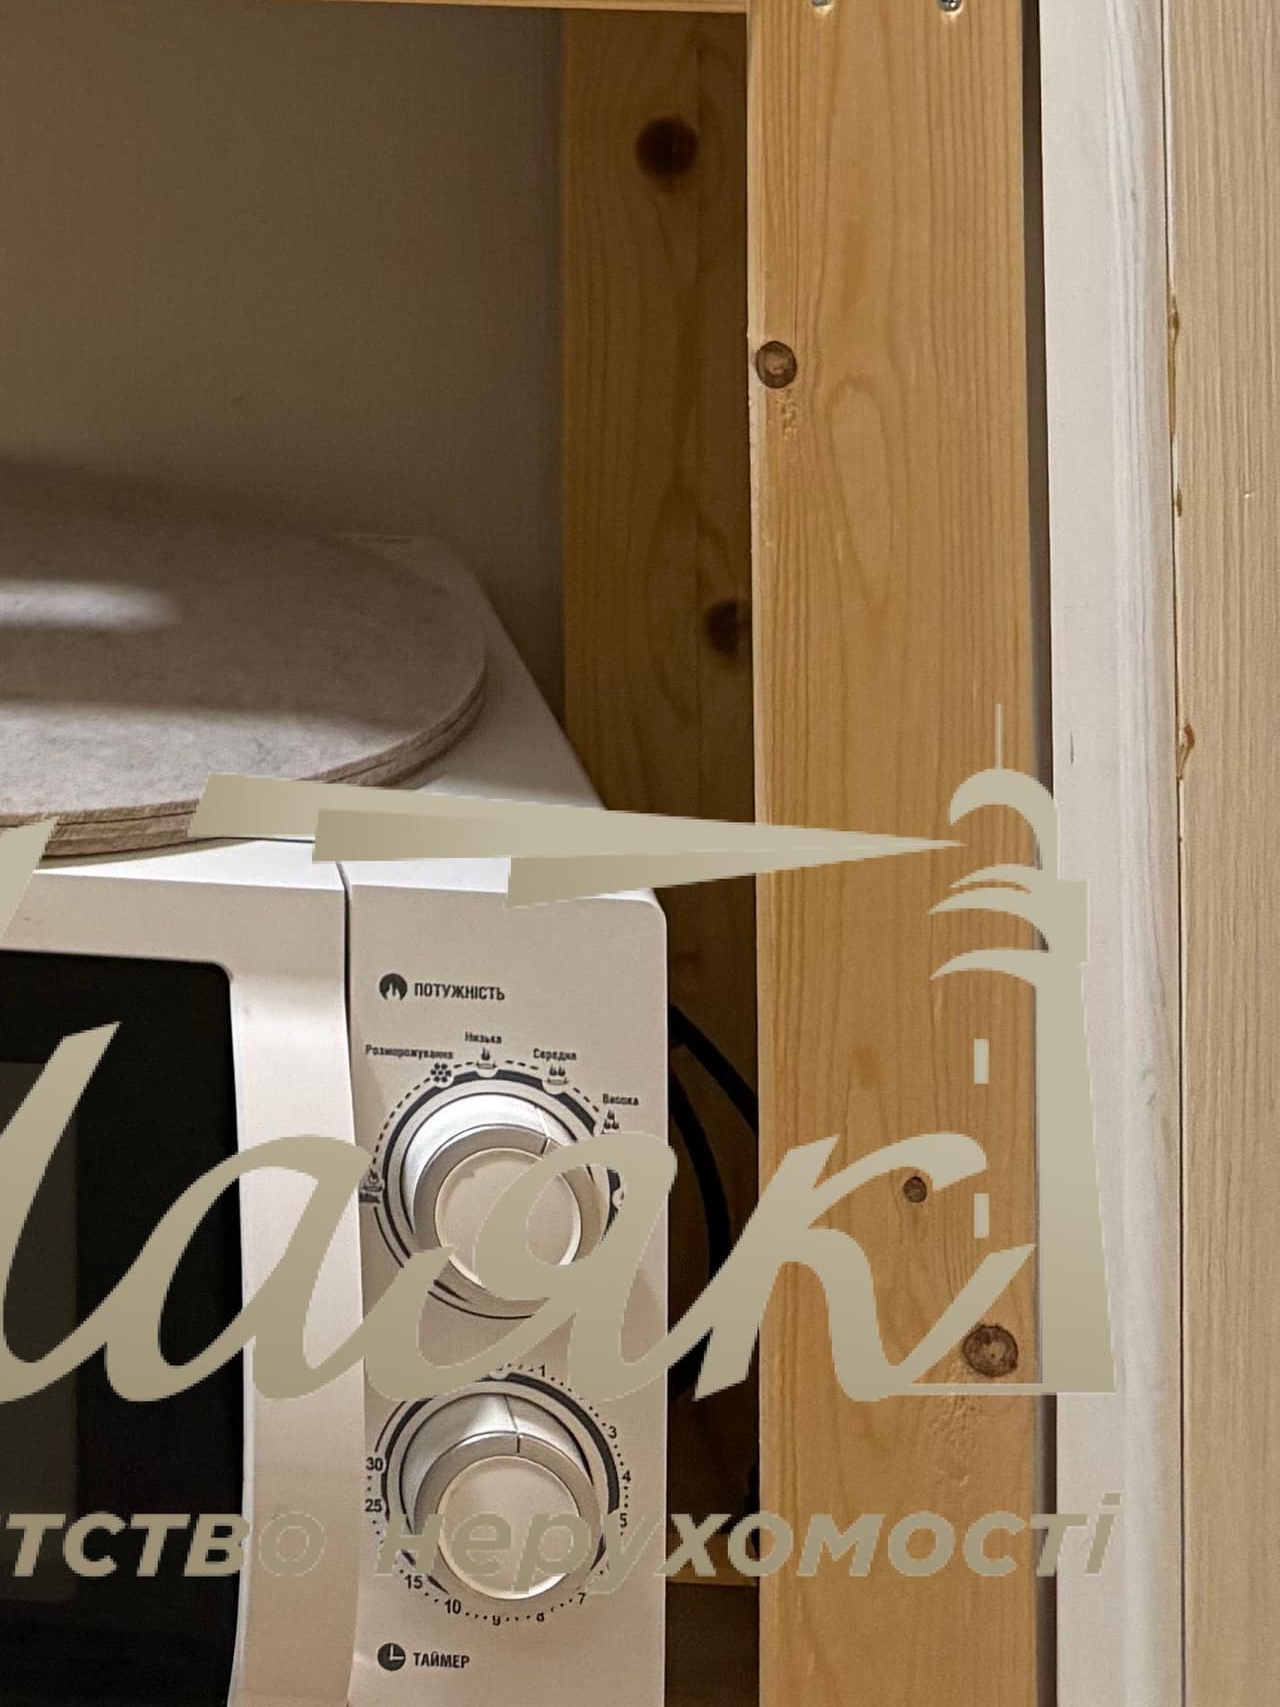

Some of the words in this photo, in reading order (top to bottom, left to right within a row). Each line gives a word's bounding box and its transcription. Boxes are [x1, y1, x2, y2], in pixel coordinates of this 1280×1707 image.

[414, 982, 505, 1001] ПОТУЖНІСТЬ
[464, 1031, 502, 1044] Низька
[365, 1044, 454, 1060] Розморожування
[533, 1048, 577, 1061] Середня
[602, 1093, 639, 1107] Висока
[608, 1426, 618, 1439] 3
[366, 1457, 383, 1471] 30
[622, 1470, 631, 1482] 4
[365, 1499, 382, 1513] 25
[619, 1513, 628, 1528] 5
[404, 1575, 423, 1590] 15
[578, 1592, 587, 1605] 7
[444, 1600, 461, 1615] 10
[413, 1650, 470, 1668] ТАЙМЕР
